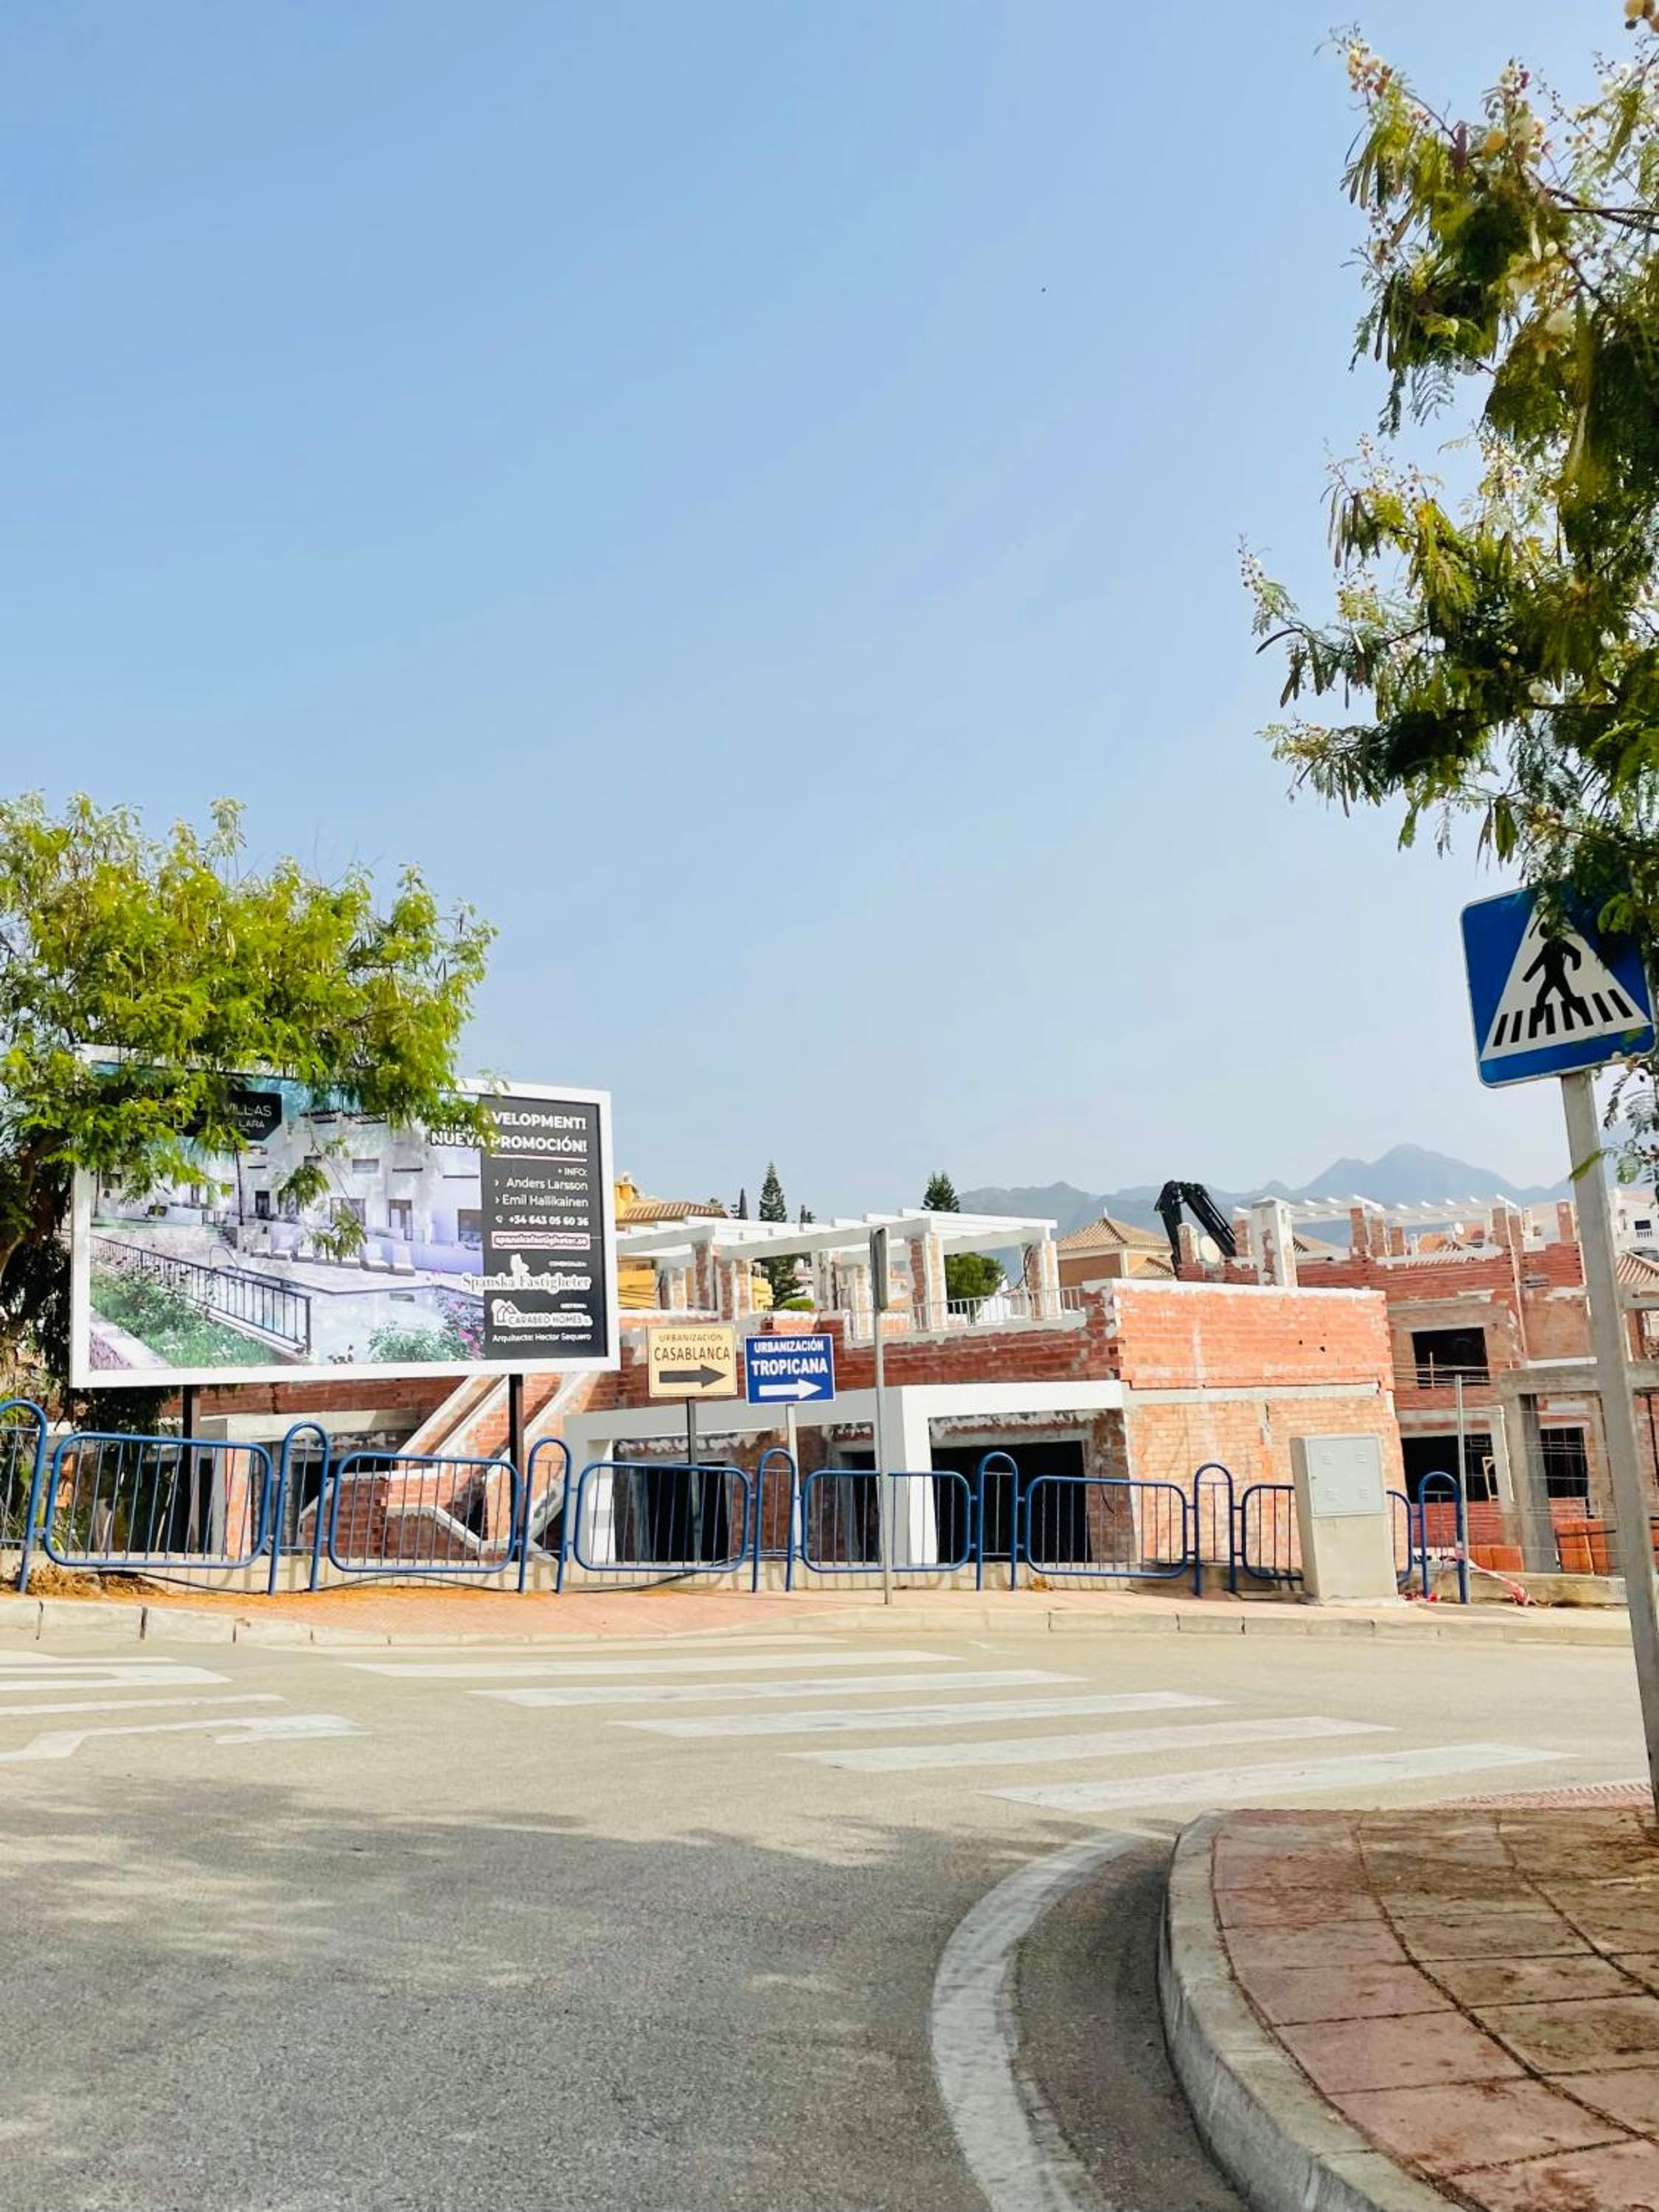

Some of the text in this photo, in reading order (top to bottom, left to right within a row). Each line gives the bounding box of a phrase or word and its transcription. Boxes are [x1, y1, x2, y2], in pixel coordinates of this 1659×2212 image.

[431, 1130, 588, 1153] NUEVA PROMOCIÓN!
[564, 1167, 588, 1177] INFO:
[507, 1178, 588, 1191] Anders Larsson
[502, 1194, 589, 1208] Emil Hallikainen
[509, 1214, 527, 1225] +34
[462, 1274, 588, 1290] Spanska Fastigheter
[553, 1315, 582, 1324] HOMES
[659, 1333, 724, 1342] URBANIZACIÓN
[754, 1338, 824, 1354] URBANIZACIÓN
[654, 1346, 731, 1362] CASABLANCA
[751, 1357, 829, 1377] TROPICANA
